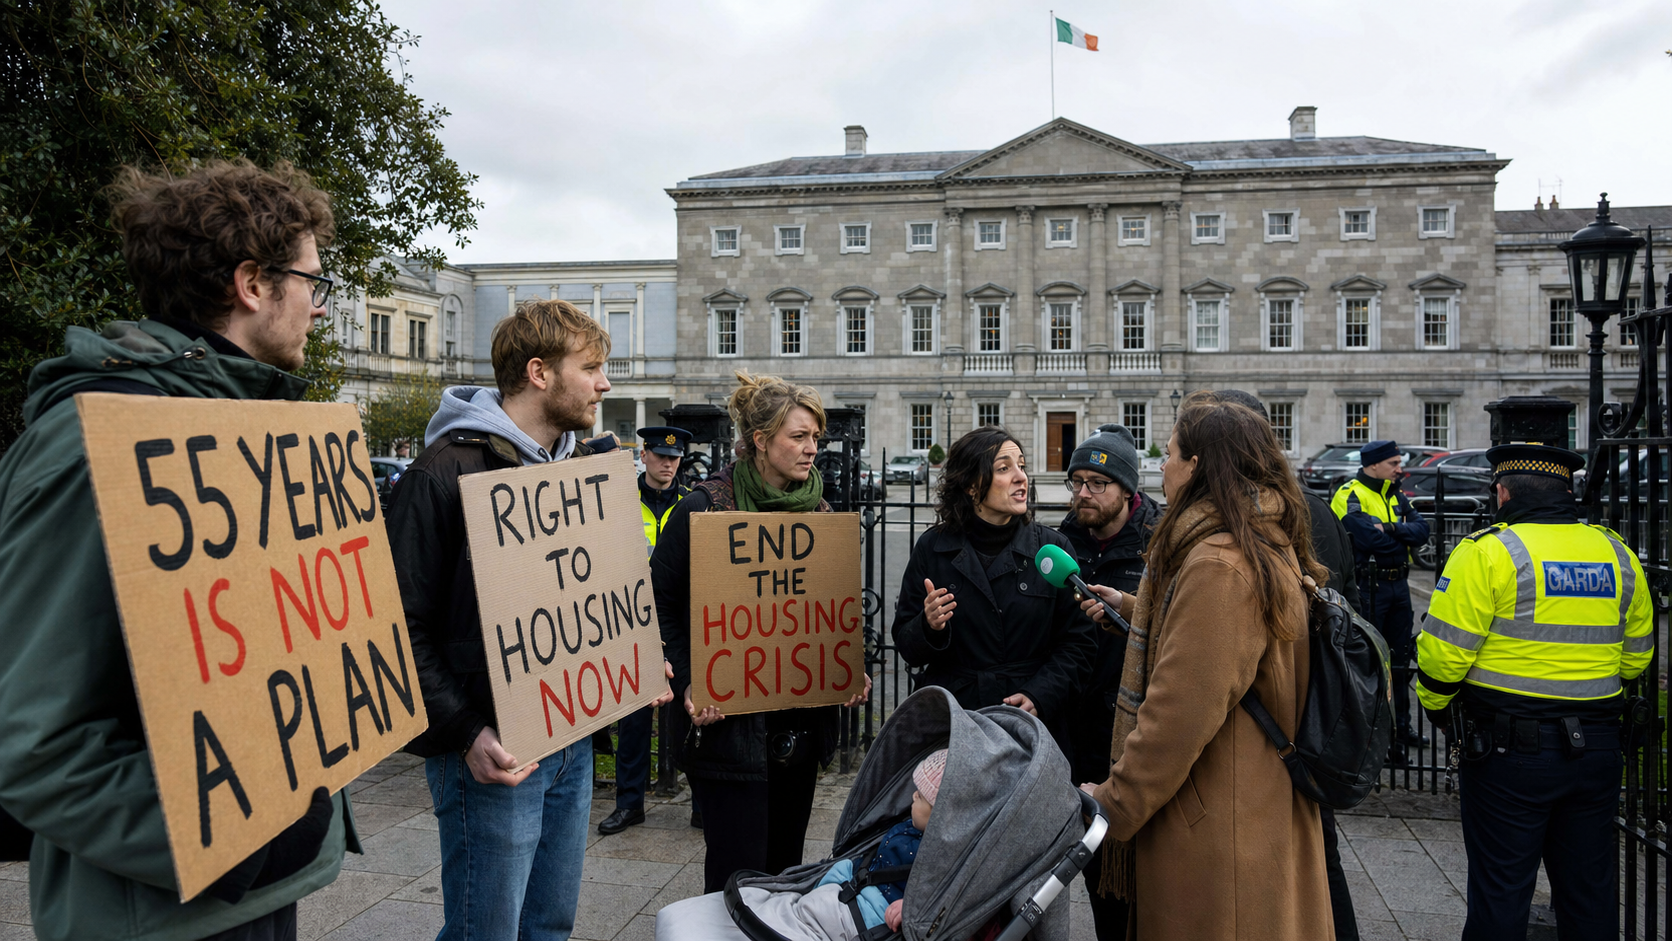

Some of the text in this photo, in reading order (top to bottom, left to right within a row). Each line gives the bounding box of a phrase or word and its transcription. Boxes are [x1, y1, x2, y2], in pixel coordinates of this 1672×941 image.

[134, 430, 377, 571] 55 YEARS
[490, 473, 609, 547] RIGHT
[545, 546, 591, 590] TO
[728, 522, 815, 564] END
[184, 536, 374, 684] IS NOT
[748, 567, 806, 598] THE
[1548, 566, 1614, 592] GARDA
[496, 578, 652, 683] HOUSING
[703, 596, 860, 647] HOUSING
[539, 642, 640, 738] NOW
[706, 640, 853, 702] CRISIS
[193, 622, 416, 849] A PLAN
